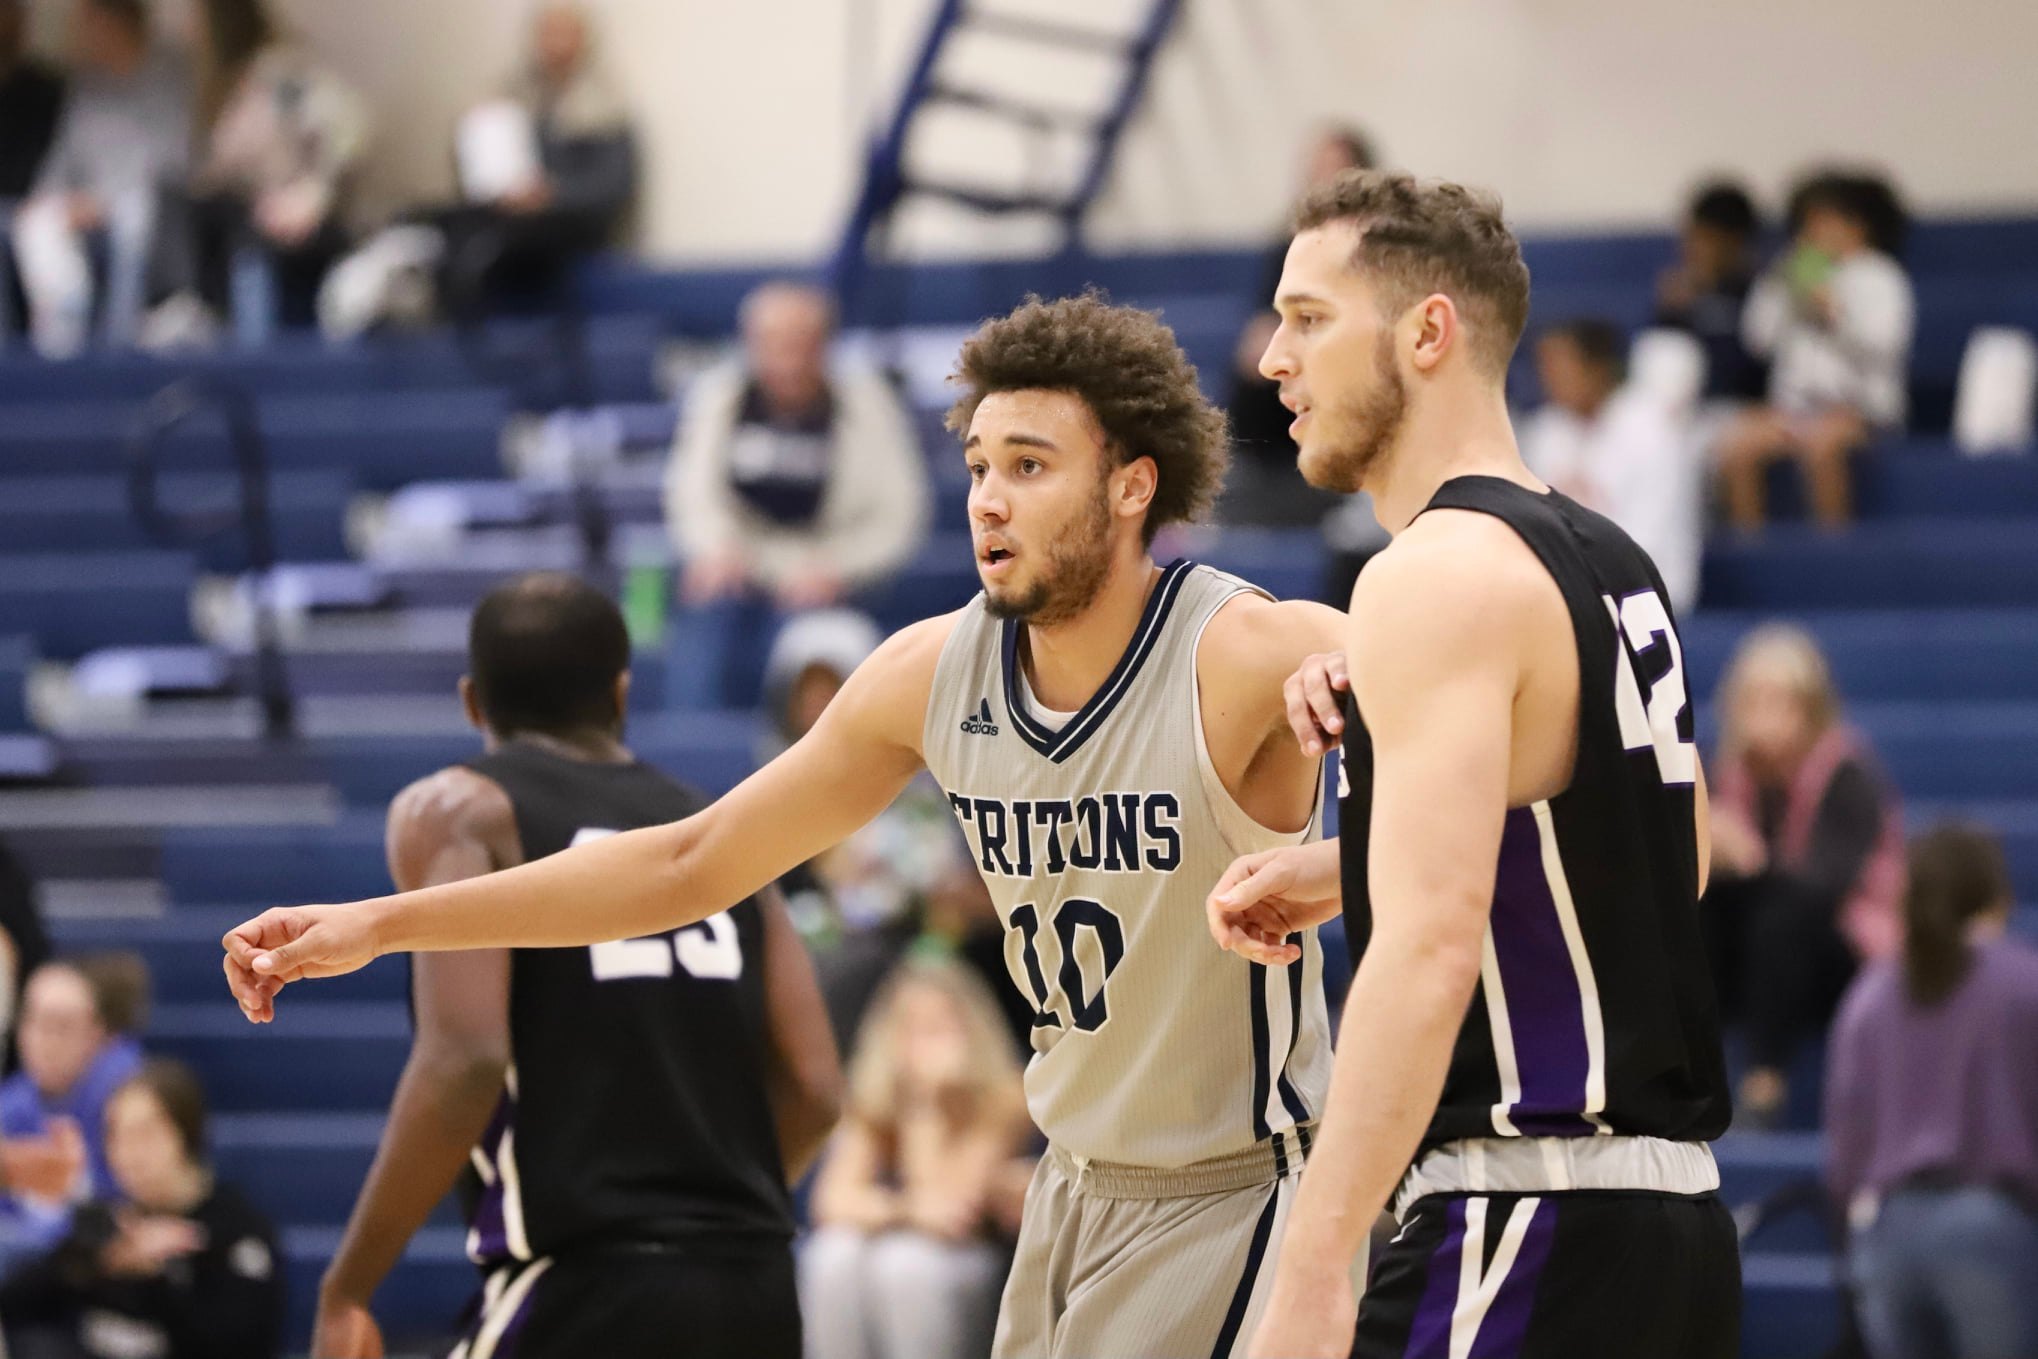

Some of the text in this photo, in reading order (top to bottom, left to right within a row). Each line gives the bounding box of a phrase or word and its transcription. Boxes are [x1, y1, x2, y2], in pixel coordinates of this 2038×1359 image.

[960, 721, 999, 736] adas
[946, 790, 1182, 877] TRITONS
[1008, 898, 1125, 1033] 10
